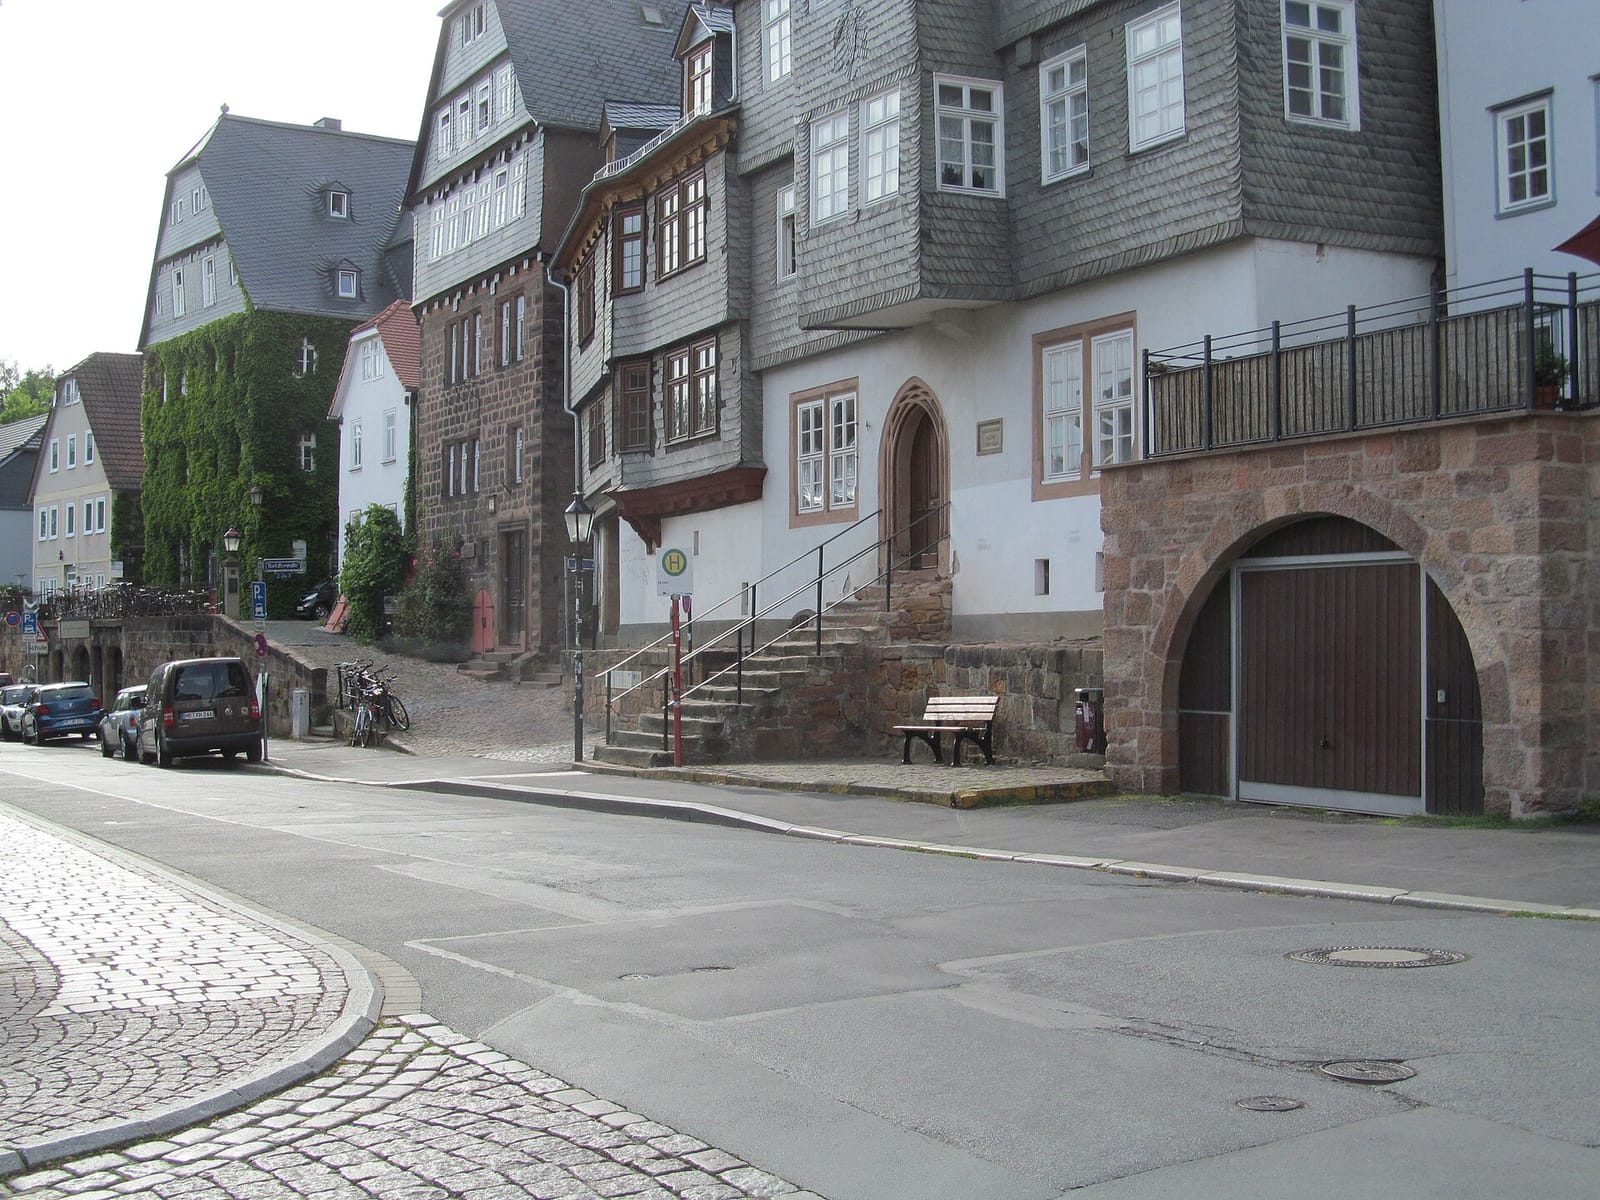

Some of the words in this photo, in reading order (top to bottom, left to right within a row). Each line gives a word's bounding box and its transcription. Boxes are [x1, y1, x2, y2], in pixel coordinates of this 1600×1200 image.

[669, 555, 680, 570] H
[253, 584, 261, 599] P
[25, 614, 30, 622] P
